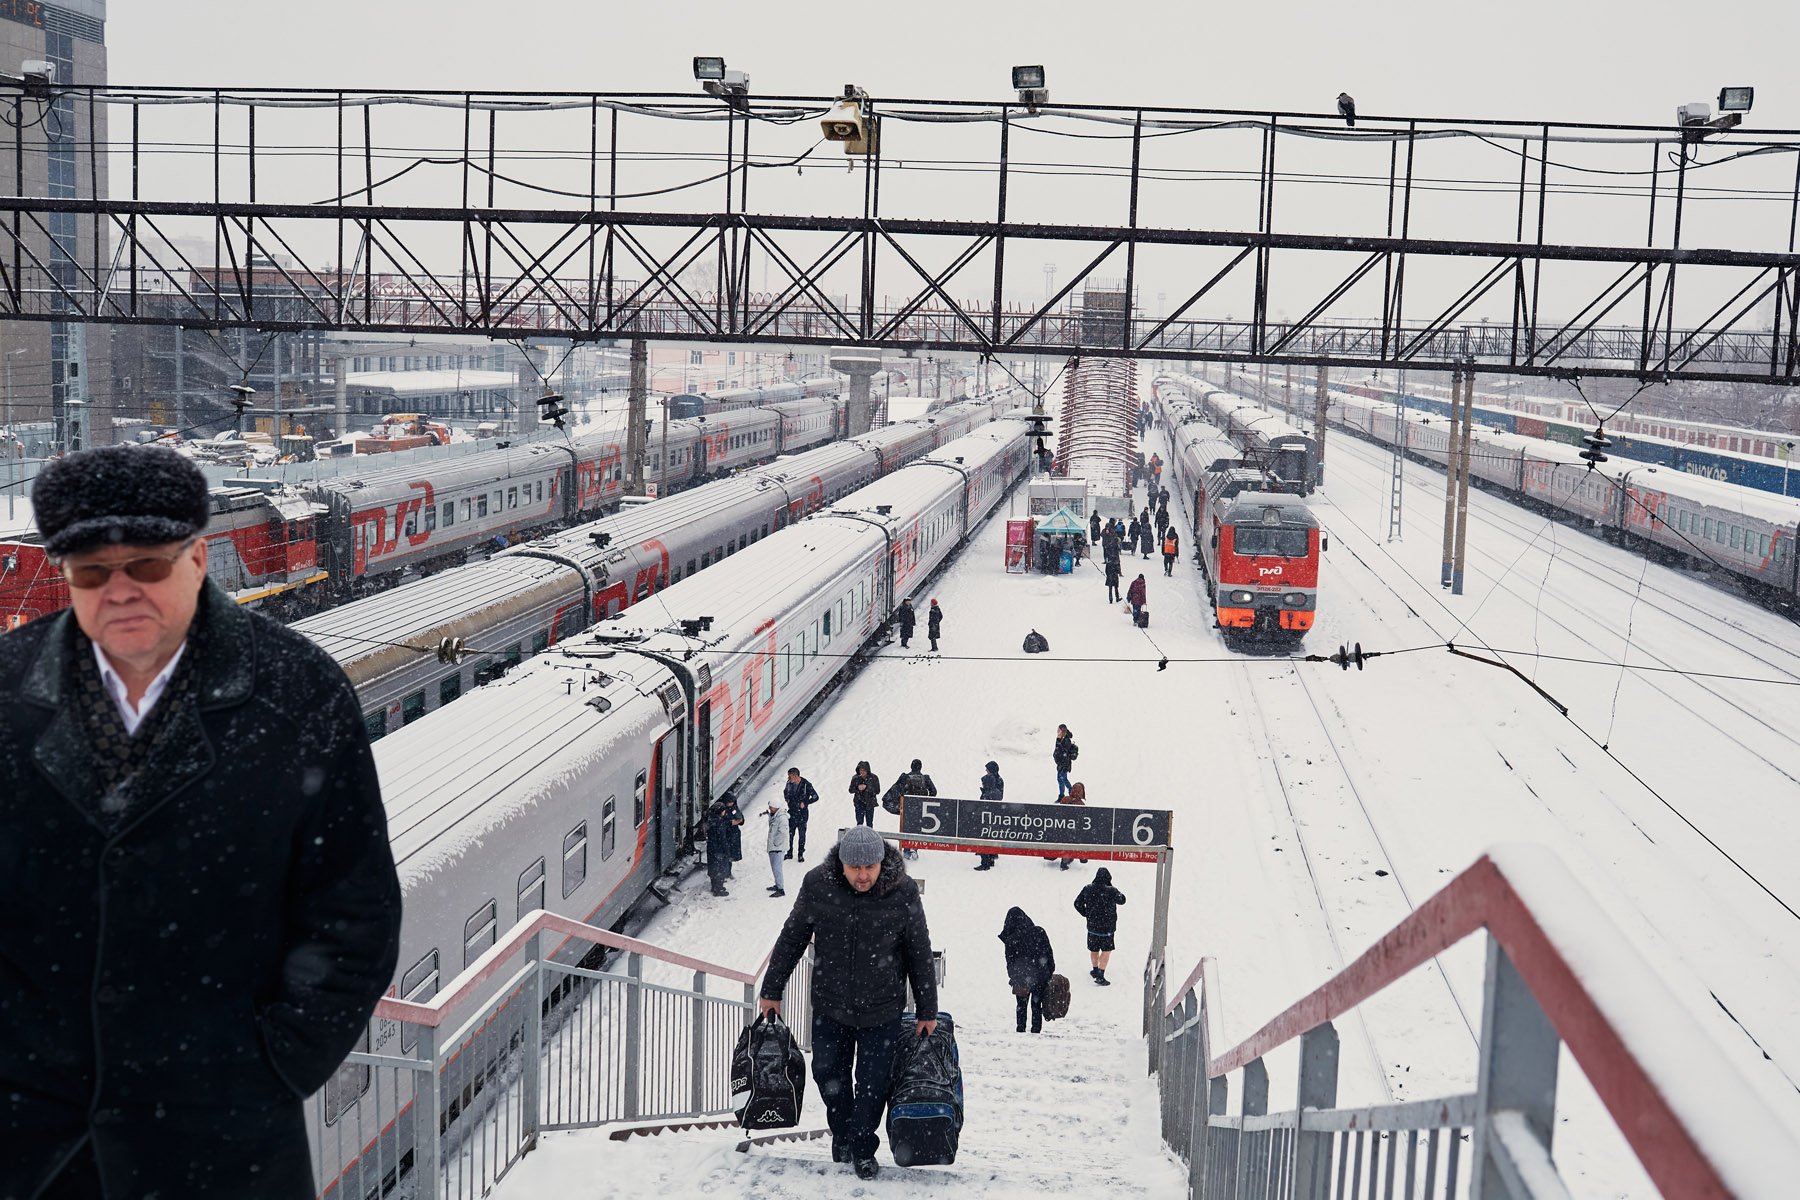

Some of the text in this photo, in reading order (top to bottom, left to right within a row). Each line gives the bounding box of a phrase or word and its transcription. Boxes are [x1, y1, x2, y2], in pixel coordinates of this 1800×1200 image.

[920, 801, 941, 834] 5
[980, 811, 1092, 832] Платформа 3
[1131, 812, 1154, 846] 6
[980, 827, 1044, 841] Platform 3
